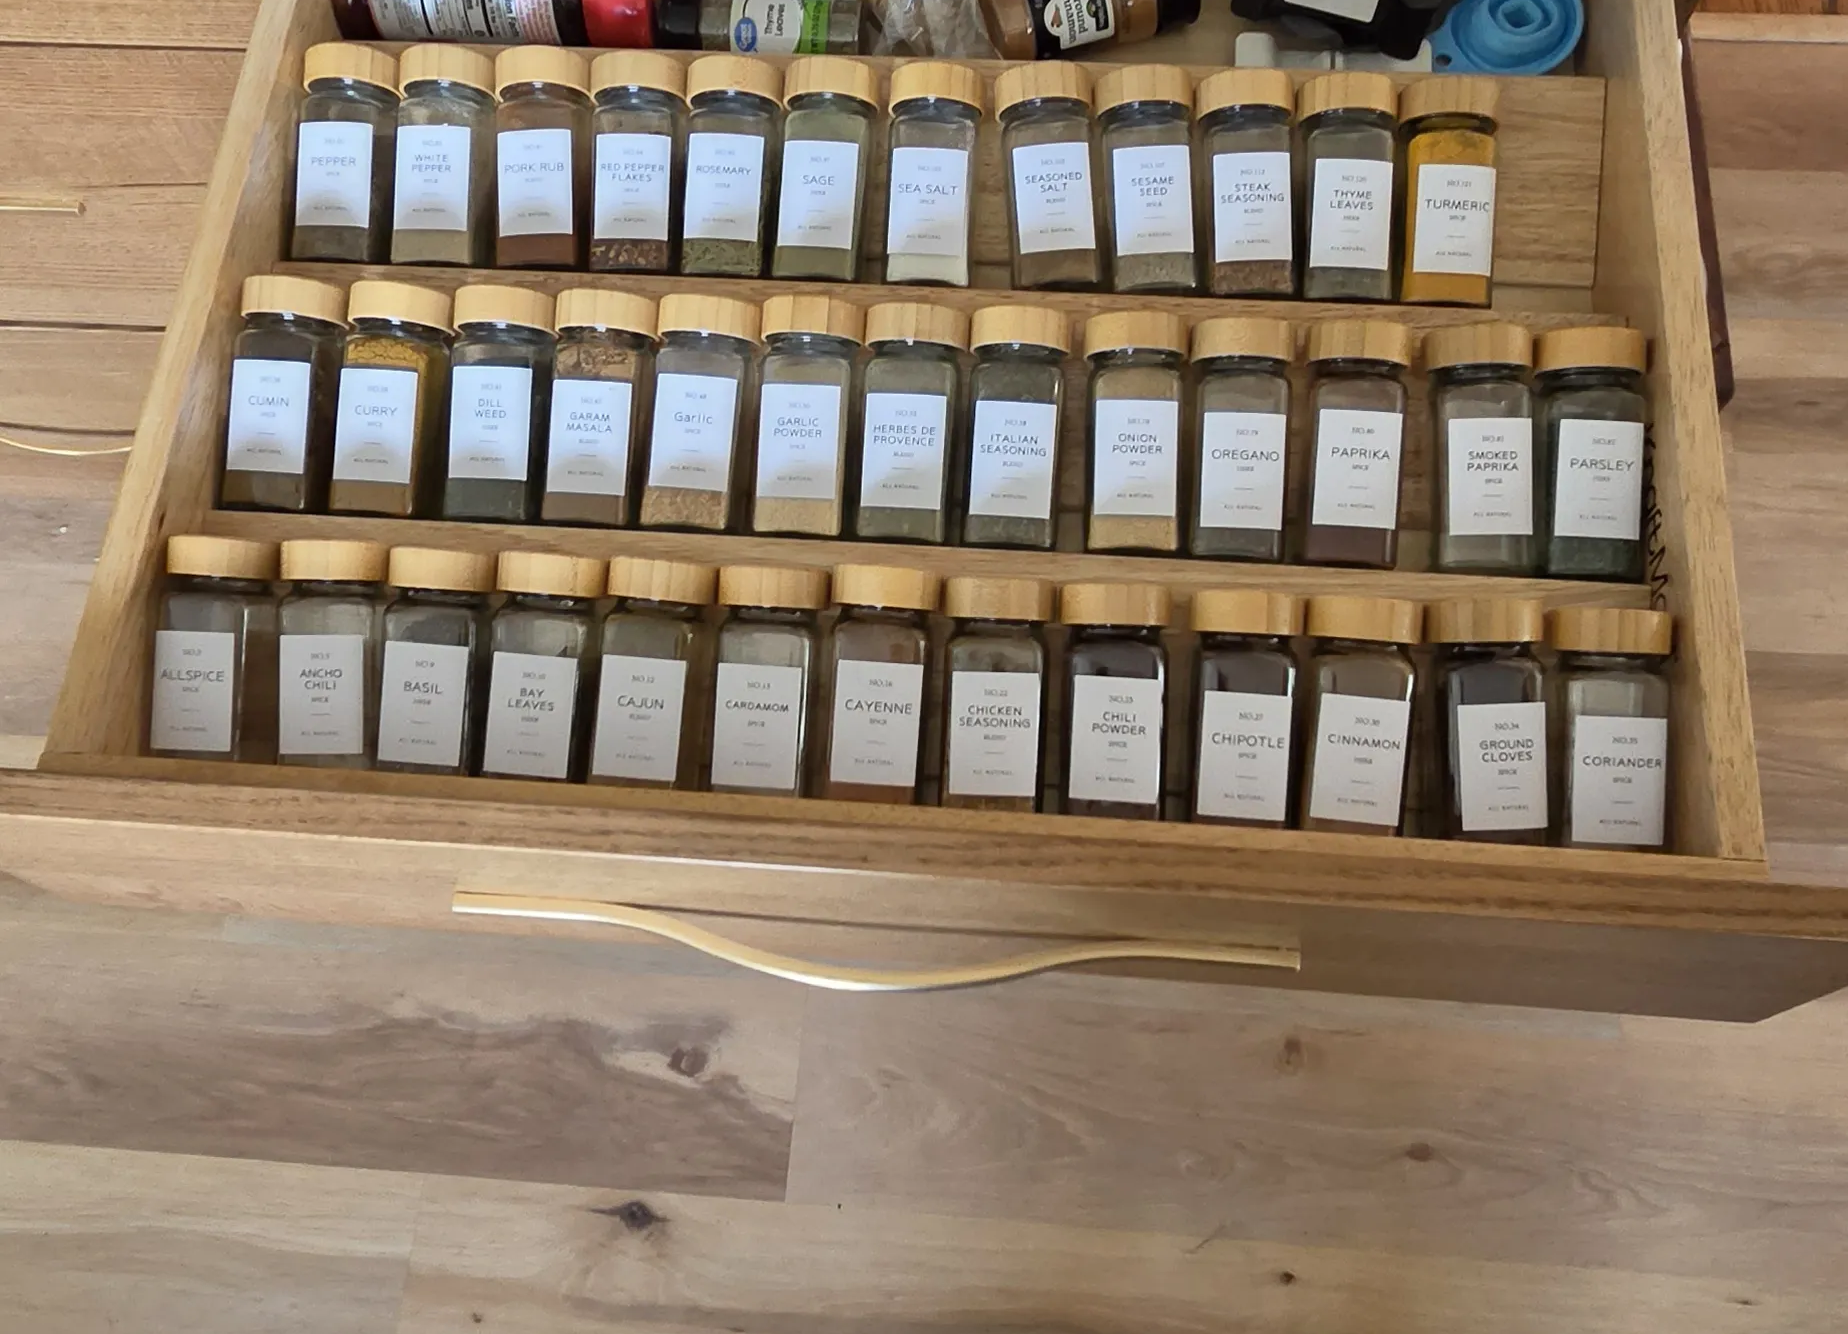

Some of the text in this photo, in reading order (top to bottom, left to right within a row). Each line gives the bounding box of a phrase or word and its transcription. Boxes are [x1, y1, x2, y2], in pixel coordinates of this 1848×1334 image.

[764, 4, 775, 35] Thyme
[774, 3, 785, 37] Leaves
[311, 156, 356, 167] PEPPER
[414, 154, 449, 163] WHITE
[411, 163, 451, 173] PEPPER
[504, 162, 565, 174] PORK RUB
[600, 163, 665, 173] RED PEPPER
[696, 165, 752, 176] ROSEMARY
[611, 173, 652, 183] FLAKES
[802, 174, 835, 186] SAGE
[1024, 171, 1083, 184] SEASONED
[1131, 176, 1175, 187] SESAME
[897, 183, 958, 196] SEA SALT
[1040, 182, 1068, 193] SALT
[1139, 187, 1169, 197] SEED
[1234, 183, 1272, 193] STEAK
[1220, 193, 1285, 204] SEASONING
[1333, 189, 1373, 200] THYME
[1330, 199, 1374, 211] LEAVES
[1425, 198, 1490, 212] TURMERIC
[248, 395, 290, 407] CUMIN
[478, 398, 503, 408] DILL
[354, 404, 398, 417] CURRY
[474, 409, 507, 419] WEED
[569, 411, 611, 422] GARAM
[674, 411, 713, 425] Garlic
[777, 417, 819, 427] GARLIC
[565, 422, 613, 433] MASALA
[773, 427, 822, 438] POWDER
[873, 424, 937, 436] HERBES DE
[873, 435, 935, 447] PROVENCE
[990, 433, 1039, 445] ITALIAN
[1118, 433, 1157, 443] ONION
[980, 444, 1047, 457] SEASONING
[1112, 444, 1163, 454] POWDER
[1211, 448, 1280, 462] OREGANO
[1331, 447, 1390, 460] PAPRIKA
[1468, 450, 1518, 460] SMOKED
[1466, 461, 1519, 472] PAPRIKA
[1570, 457, 1636, 472] PARSLEY
[159, 668, 225, 683] ALLSPICE
[300, 668, 343, 679] ANCHO
[304, 680, 337, 691] CHILI
[403, 681, 443, 695] BASIL
[519, 688, 545, 699] BAY
[507, 698, 555, 712] LEAVES
[617, 694, 665, 710] CAJUN
[725, 699, 789, 713] CARDAMOM
[844, 698, 913, 715] CAYENNE
[967, 704, 1023, 716] CHICKEN
[958, 716, 1031, 729] SEASONING
[1103, 711, 1137, 723] CHILI
[1091, 722, 1147, 736] POWDER
[1211, 732, 1285, 750] CHIPOTLE
[1327, 733, 1401, 750] CINNAMON
[1478, 739, 1535, 750] GROUND
[1481, 750, 1533, 763] CLOVES
[1582, 755, 1663, 769] CORIANDER
